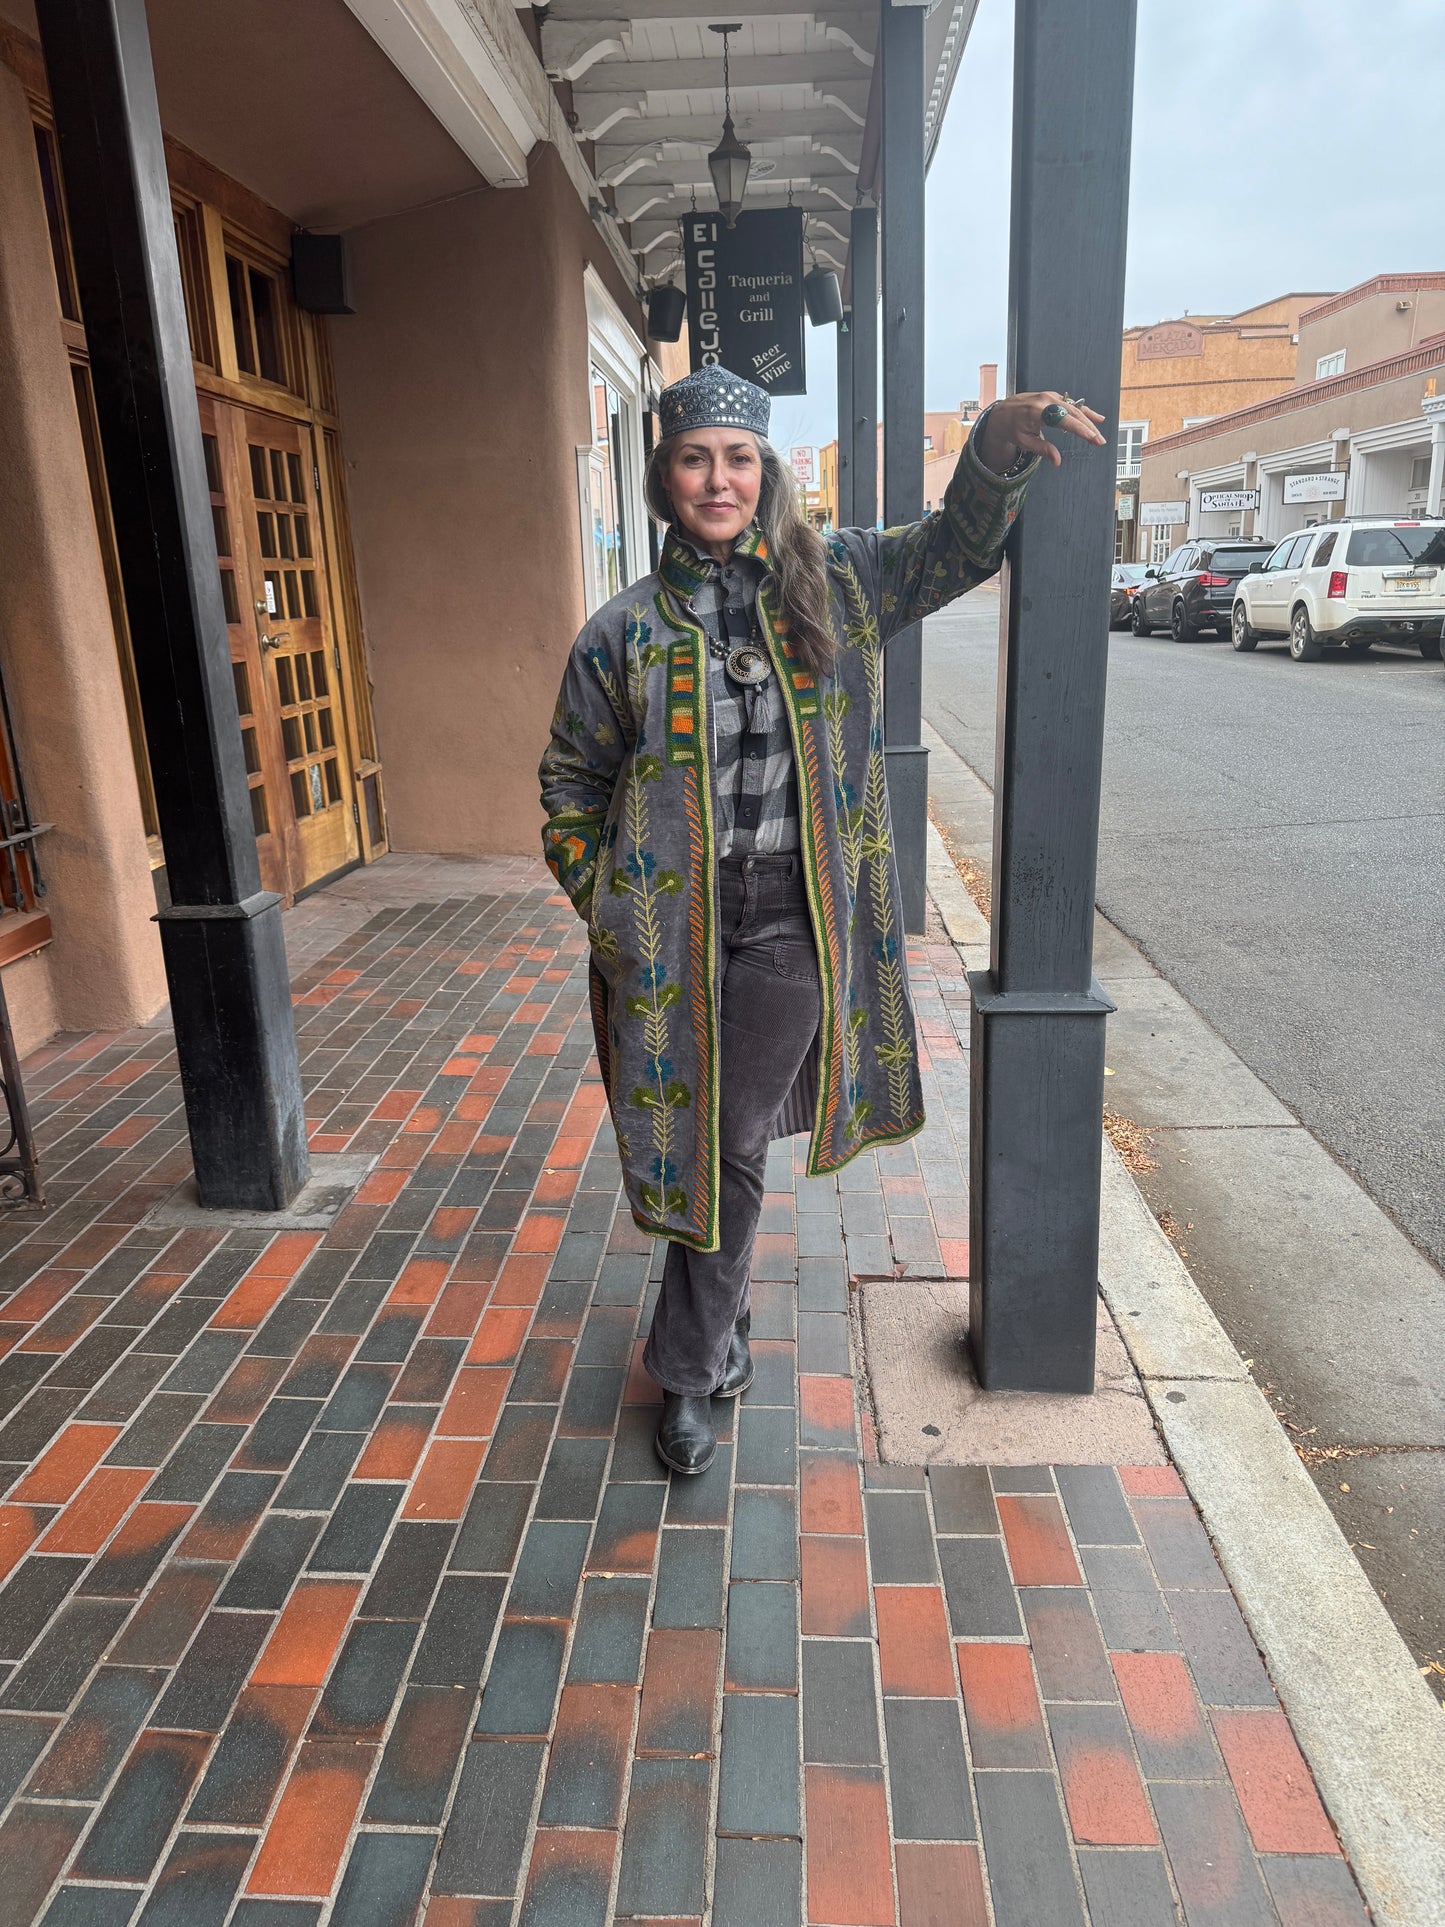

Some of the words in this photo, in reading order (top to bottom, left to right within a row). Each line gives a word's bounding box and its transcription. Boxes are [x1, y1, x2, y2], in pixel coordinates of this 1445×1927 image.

[693, 222, 718, 243] El
[727, 271, 793, 289] Taqueria
[748, 291, 770, 302] and
[739, 307, 774, 323] Grill
[1153, 330, 1187, 342] PLAZA
[1142, 340, 1196, 354] MERCADO
[751, 342, 781, 368] Beer
[759, 358, 792, 385] Wine
[797, 449, 806, 457] NO
[1289, 476, 1314, 488] STANDARD
[1319, 475, 1340, 485] STRANGE
[1203, 493, 1232, 504] OPTICAL
[1234, 493, 1254, 501] SHOP
[1212, 500, 1234, 508] SANTA
